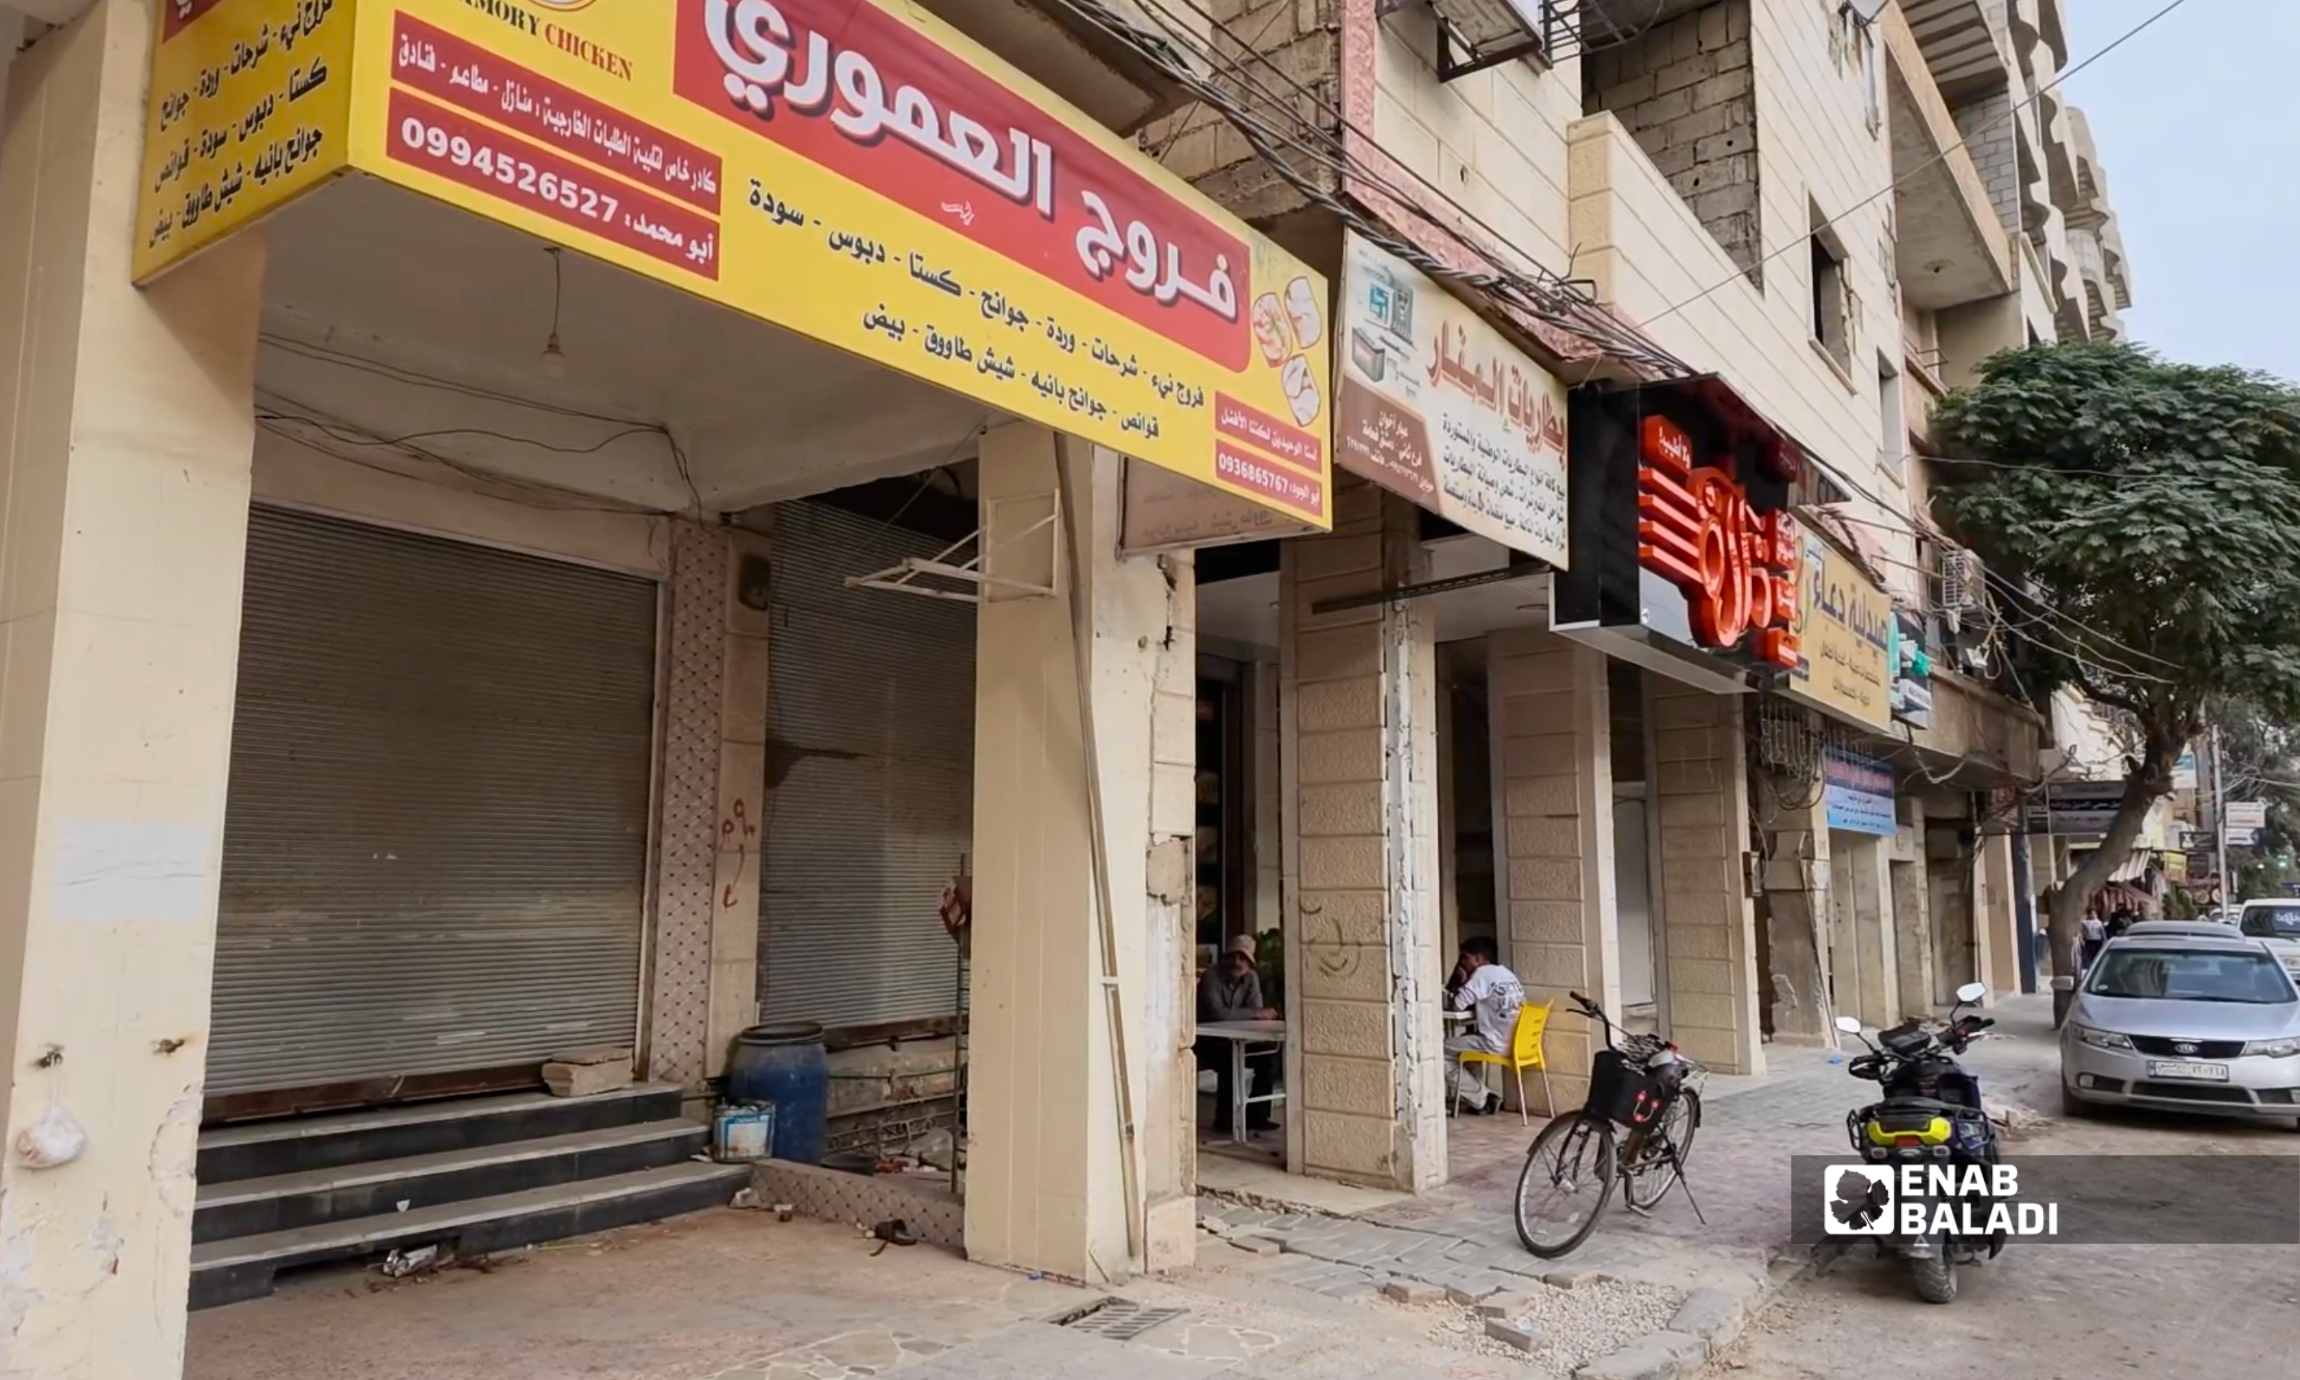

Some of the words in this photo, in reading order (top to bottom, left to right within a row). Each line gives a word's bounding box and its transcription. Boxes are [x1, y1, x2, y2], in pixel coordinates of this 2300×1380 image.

[231, 24, 268, 75] شرحات
[398, 34, 436, 72] فنادق
[462, 0, 541, 36] MORY
[544, 23, 633, 81] CHICKEN
[200, 68, 220, 98] وردة
[289, 56, 328, 102] كستا
[450, 64, 489, 93] مطاعم
[501, 79, 532, 113] منازل
[161, 92, 190, 132] جوانح
[239, 94, 273, 142] دبوس
[704, 0, 1053, 216] العموري
[200, 129, 227, 159] سودة
[285, 126, 322, 174] جوانح
[593, 118, 632, 157] الطلبات
[155, 138, 190, 193] قوانص
[401, 116, 619, 223] 0994526527
[665, 156, 690, 182] خاص
[691, 168, 716, 194] كادر
[215, 162, 243, 212] شيش
[749, 178, 805, 226] سودة
[150, 208, 172, 248] بيض
[828, 230, 886, 265] دبوس
[686, 233, 714, 264] أبو
[1074, 188, 1239, 320] فروج
[909, 251, 962, 297] كستا
[863, 302, 906, 342] بيض
[980, 289, 1030, 332] جوانح
[924, 323, 973, 362] طاووق
[1046, 316, 1076, 353] وردة
[976, 346, 1016, 381] شيش
[1091, 337, 1138, 378] شرحات
[1427, 320, 1504, 412] المنار
[1031, 370, 1066, 405] بانيه
[1067, 386, 1107, 421] جوانح
[1151, 373, 1174, 400] نيء
[1176, 380, 1204, 408] فروج
[1121, 412, 1159, 439] قوانص
[1507, 364, 1565, 472] بطاريات
[1813, 558, 1846, 625] دعاء
